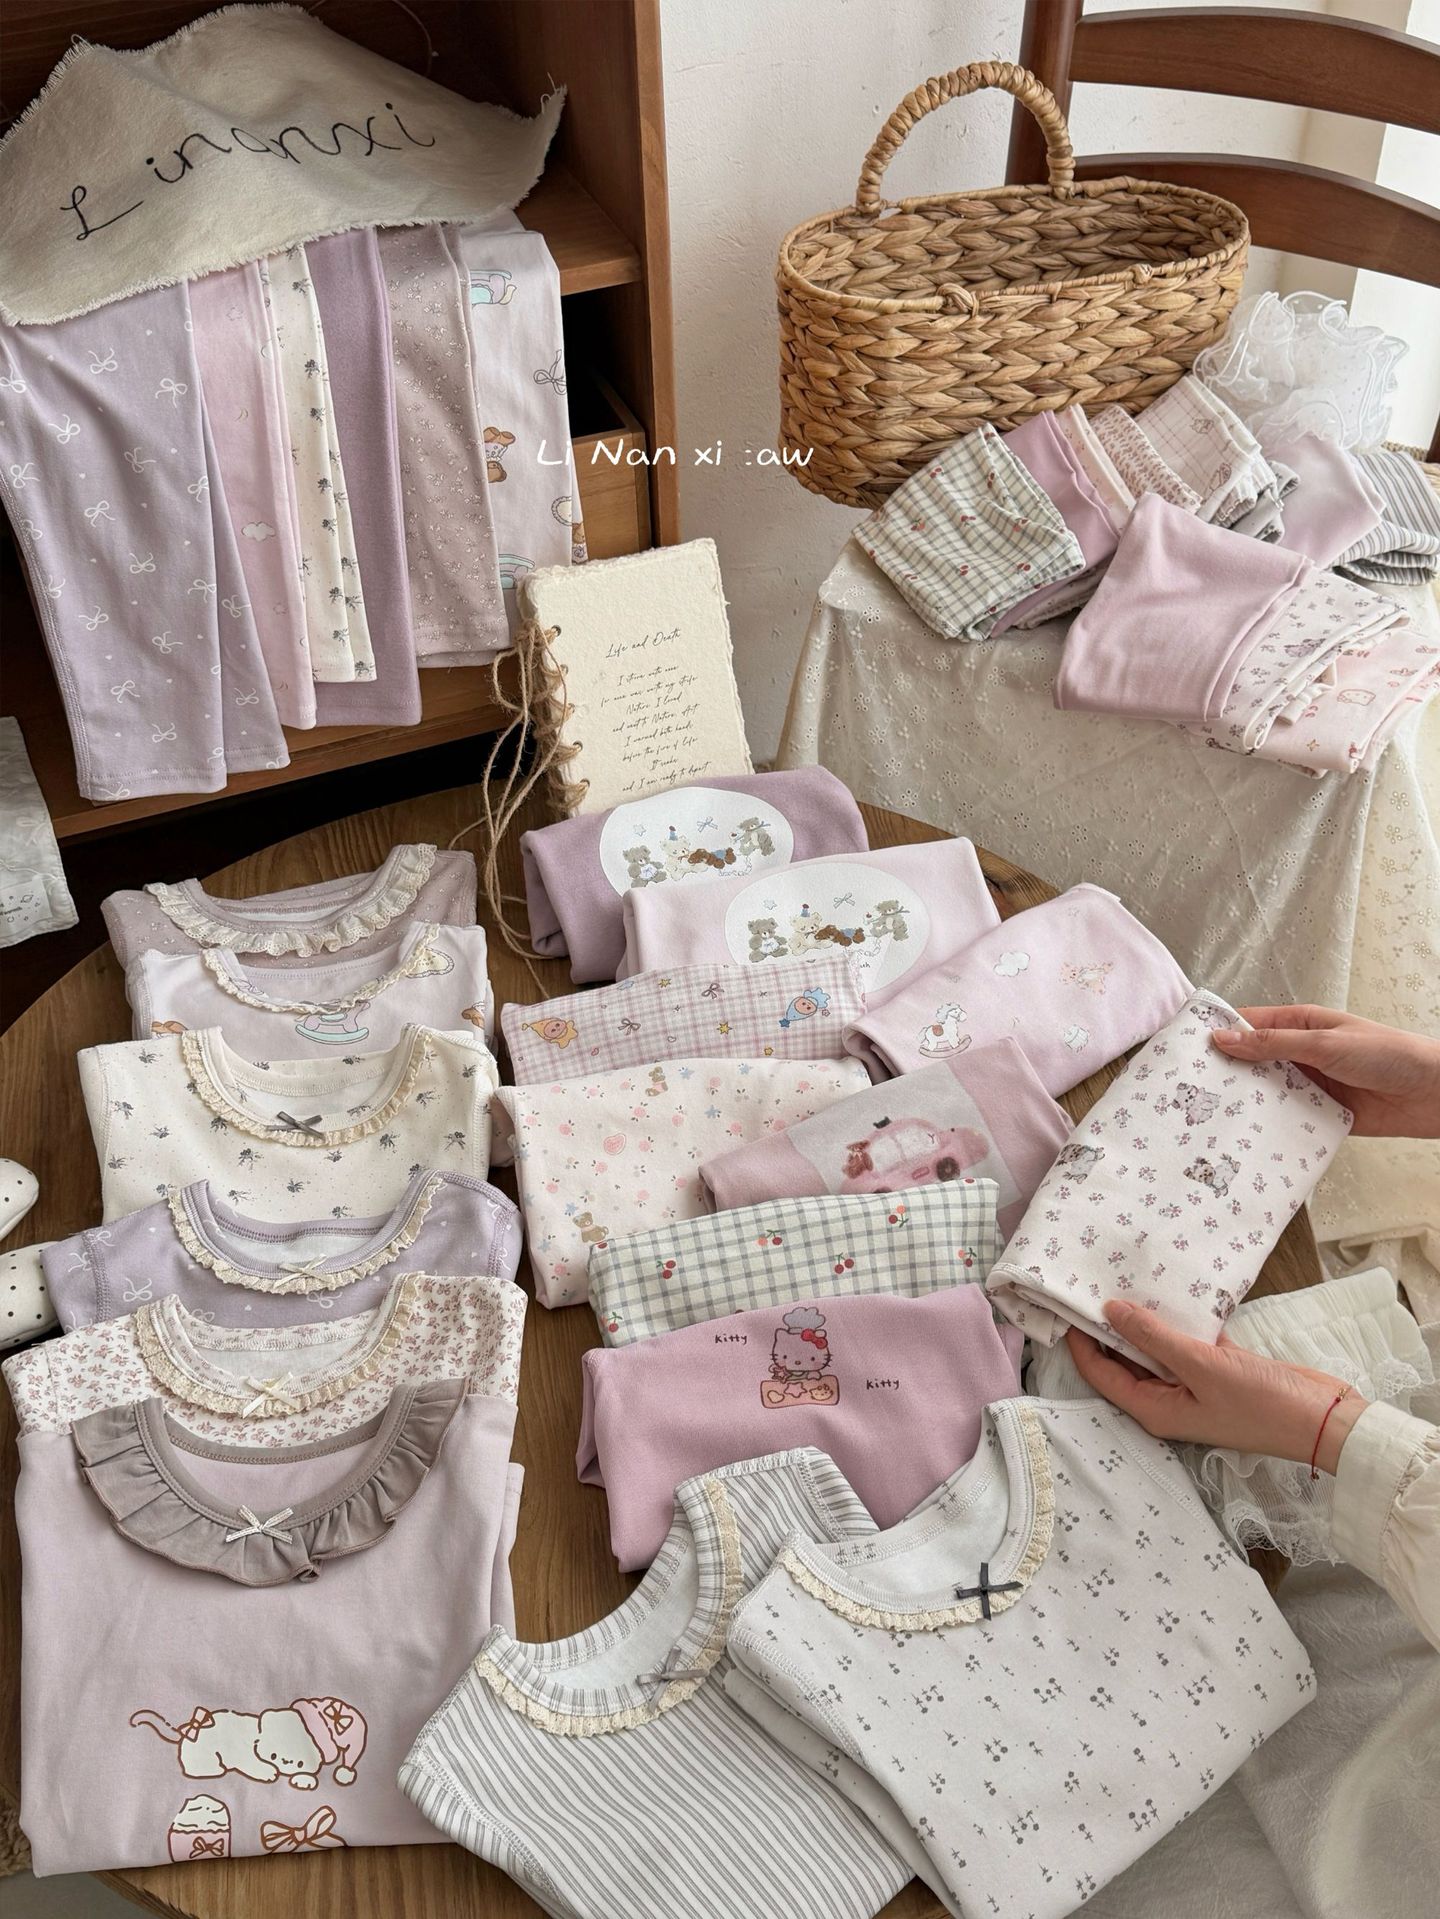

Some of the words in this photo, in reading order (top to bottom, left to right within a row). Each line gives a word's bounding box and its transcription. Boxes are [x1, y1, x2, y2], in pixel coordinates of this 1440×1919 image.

[606, 644, 628, 658] Life
[632, 635, 649, 650] and
[652, 628, 681, 646] Death
